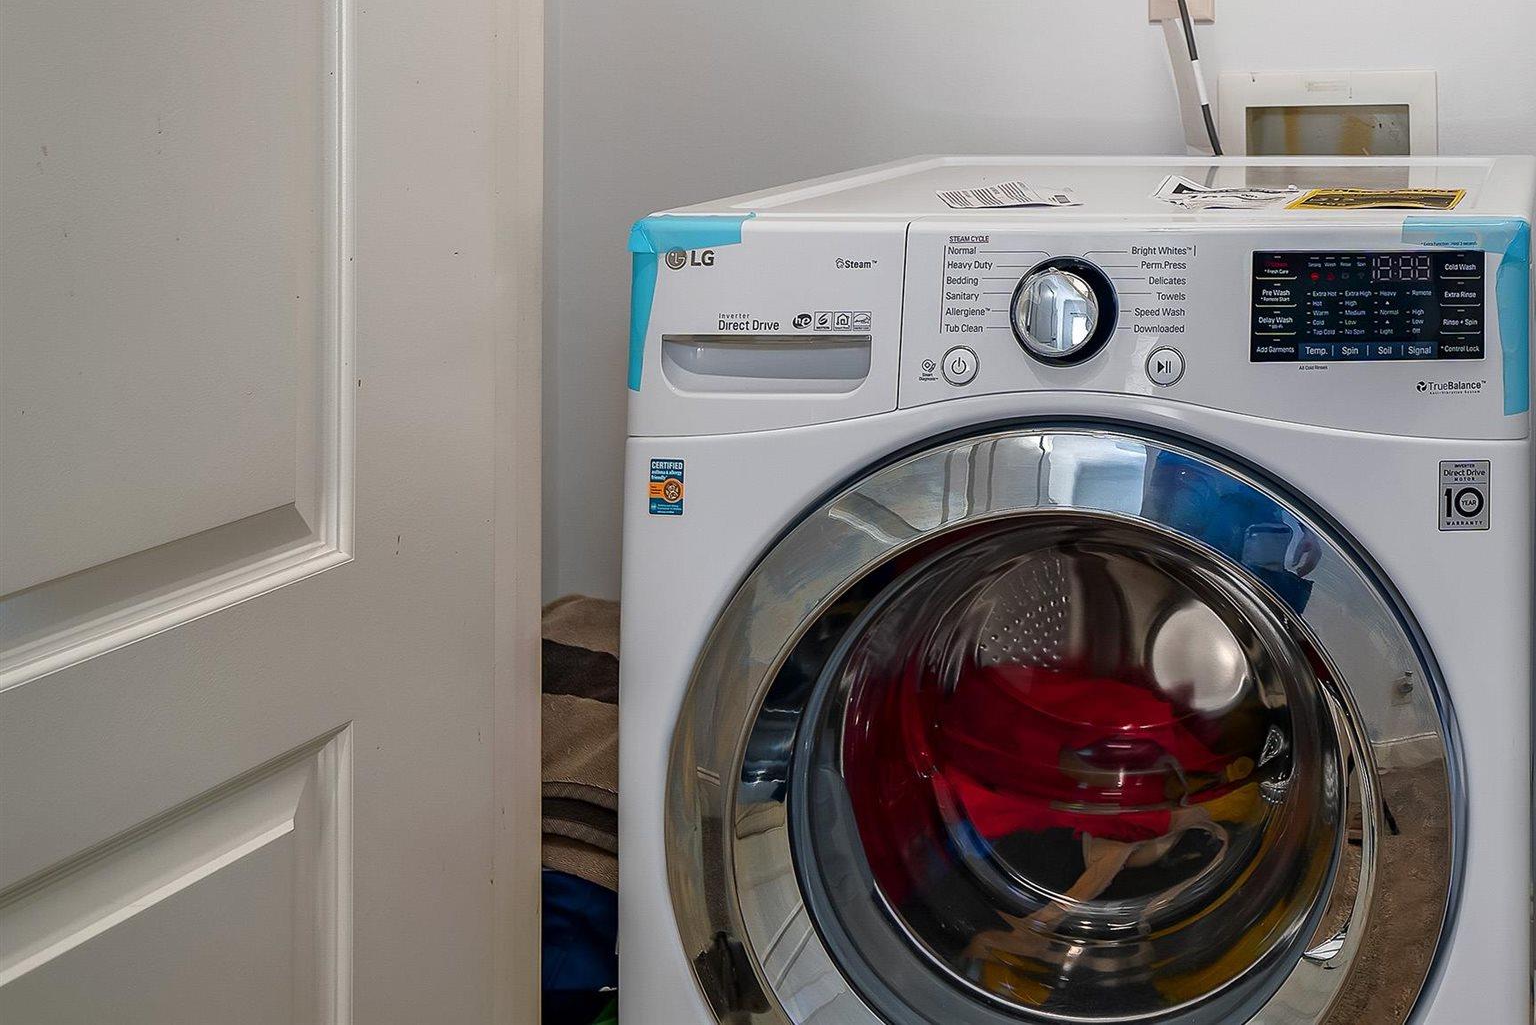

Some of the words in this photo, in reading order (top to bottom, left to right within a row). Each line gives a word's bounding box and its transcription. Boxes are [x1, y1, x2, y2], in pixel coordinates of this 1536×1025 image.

[947, 246, 977, 255] Normal
[1131, 246, 1156, 256] Bright
[690, 250, 714, 266] LG
[947, 261, 973, 270] Heavy
[973, 260, 993, 270] Duty
[1444, 263, 1459, 271] Cold
[1459, 263, 1477, 271] Wash
[946, 276, 979, 287] Bedding
[1148, 276, 1187, 285] Delicates
[945, 291, 980, 301] Sanitary
[1156, 292, 1186, 301] Towels
[1134, 307, 1160, 318] Speed
[1162, 308, 1185, 316] Wash
[1258, 316, 1275, 324] Delay
[1276, 316, 1293, 324] Wash
[718, 319, 750, 331] Direct
[752, 319, 780, 331] Drive
[945, 324, 960, 333] Tub
[961, 324, 983, 333] Clean
[1133, 324, 1185, 333] Downloaded
[1305, 346, 1328, 355] Temp.
[1341, 346, 1359, 356] Spin
[1378, 346, 1393, 355] Soil
[1407, 346, 1432, 356] Signal
[651, 462, 683, 470] CERTIFIED
[1444, 487, 1484, 518] 10
